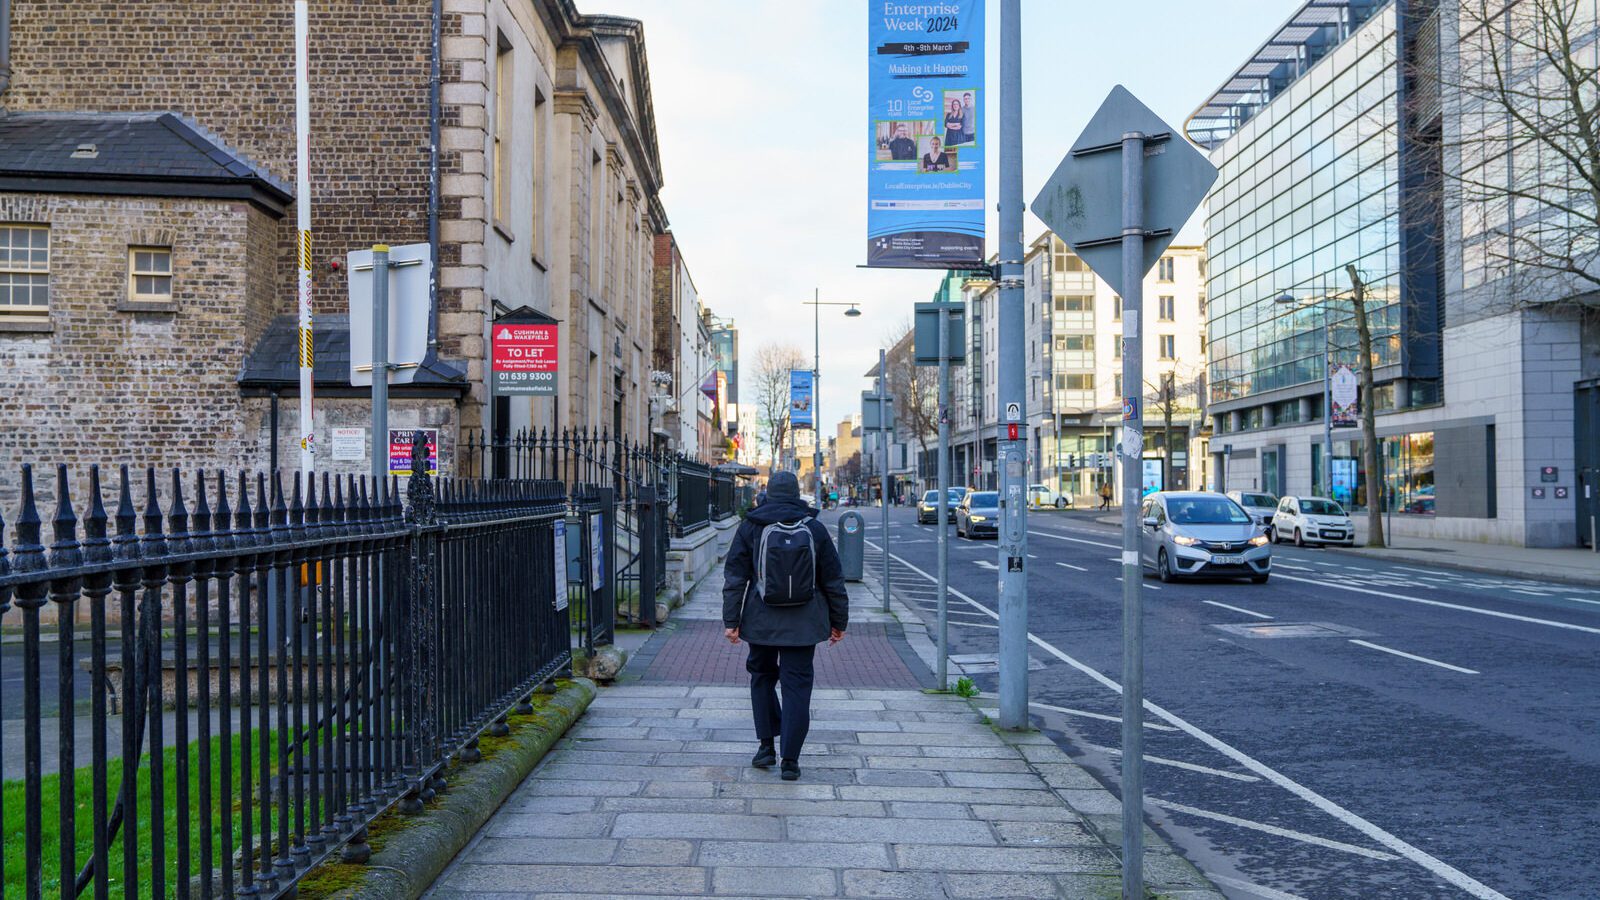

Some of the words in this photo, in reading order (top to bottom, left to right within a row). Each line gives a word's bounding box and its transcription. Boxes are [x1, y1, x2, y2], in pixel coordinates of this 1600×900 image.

[884, 2, 960, 18] Enterprise
[884, 18, 924, 31] Week
[926, 16, 958, 33] 2024
[888, 64, 922, 74] Making
[924, 64, 932, 74] it
[933, 64, 968, 74] Happen
[888, 99, 902, 112] 10
[508, 348, 522, 357] TO
[525, 348, 544, 357] LET
